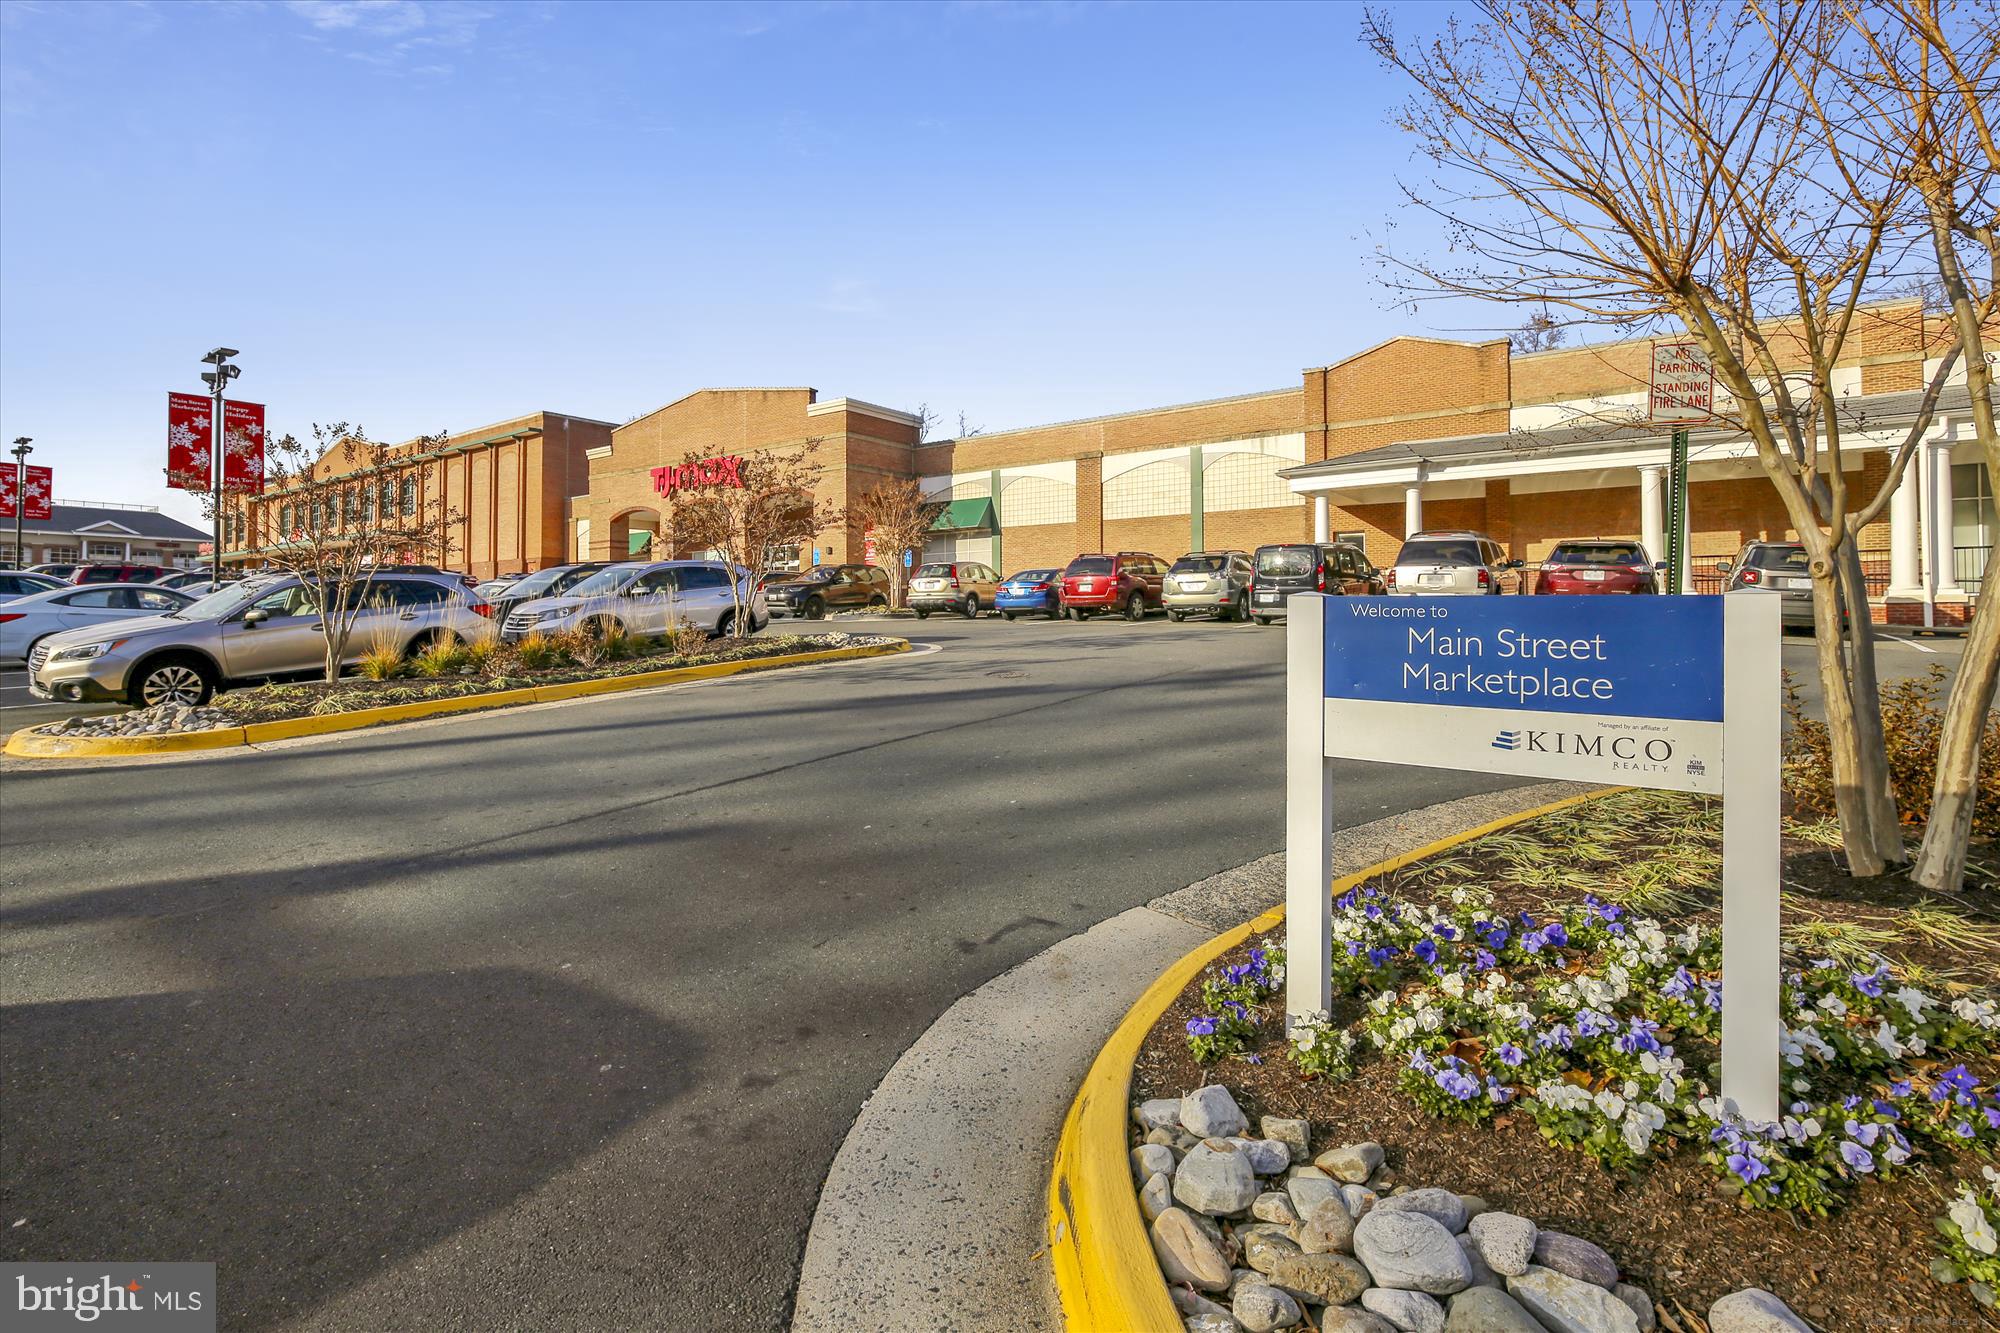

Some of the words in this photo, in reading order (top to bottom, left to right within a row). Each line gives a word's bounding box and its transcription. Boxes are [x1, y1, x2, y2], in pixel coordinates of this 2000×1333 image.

[1675, 349, 1690, 359] NO
[1659, 362, 1706, 373] PARKING
[1655, 381, 1708, 393] STANDING
[1654, 397, 1677, 408] FIRE
[1681, 395, 1708, 408] LANE
[171, 403, 209, 412] Marketplace
[226, 405, 249, 414] Happy
[226, 411, 257, 420] Holidays
[1350, 603, 1426, 618] Welcome
[1430, 605, 1448, 618] to
[1408, 626, 1483, 656] Main
[1497, 628, 1607, 660] Street
[1403, 662, 1614, 704] Marketplace
[1597, 722, 1623, 730] Managed
[1526, 730, 1672, 762] KIMCO
[1613, 762, 1668, 773] REALTY
